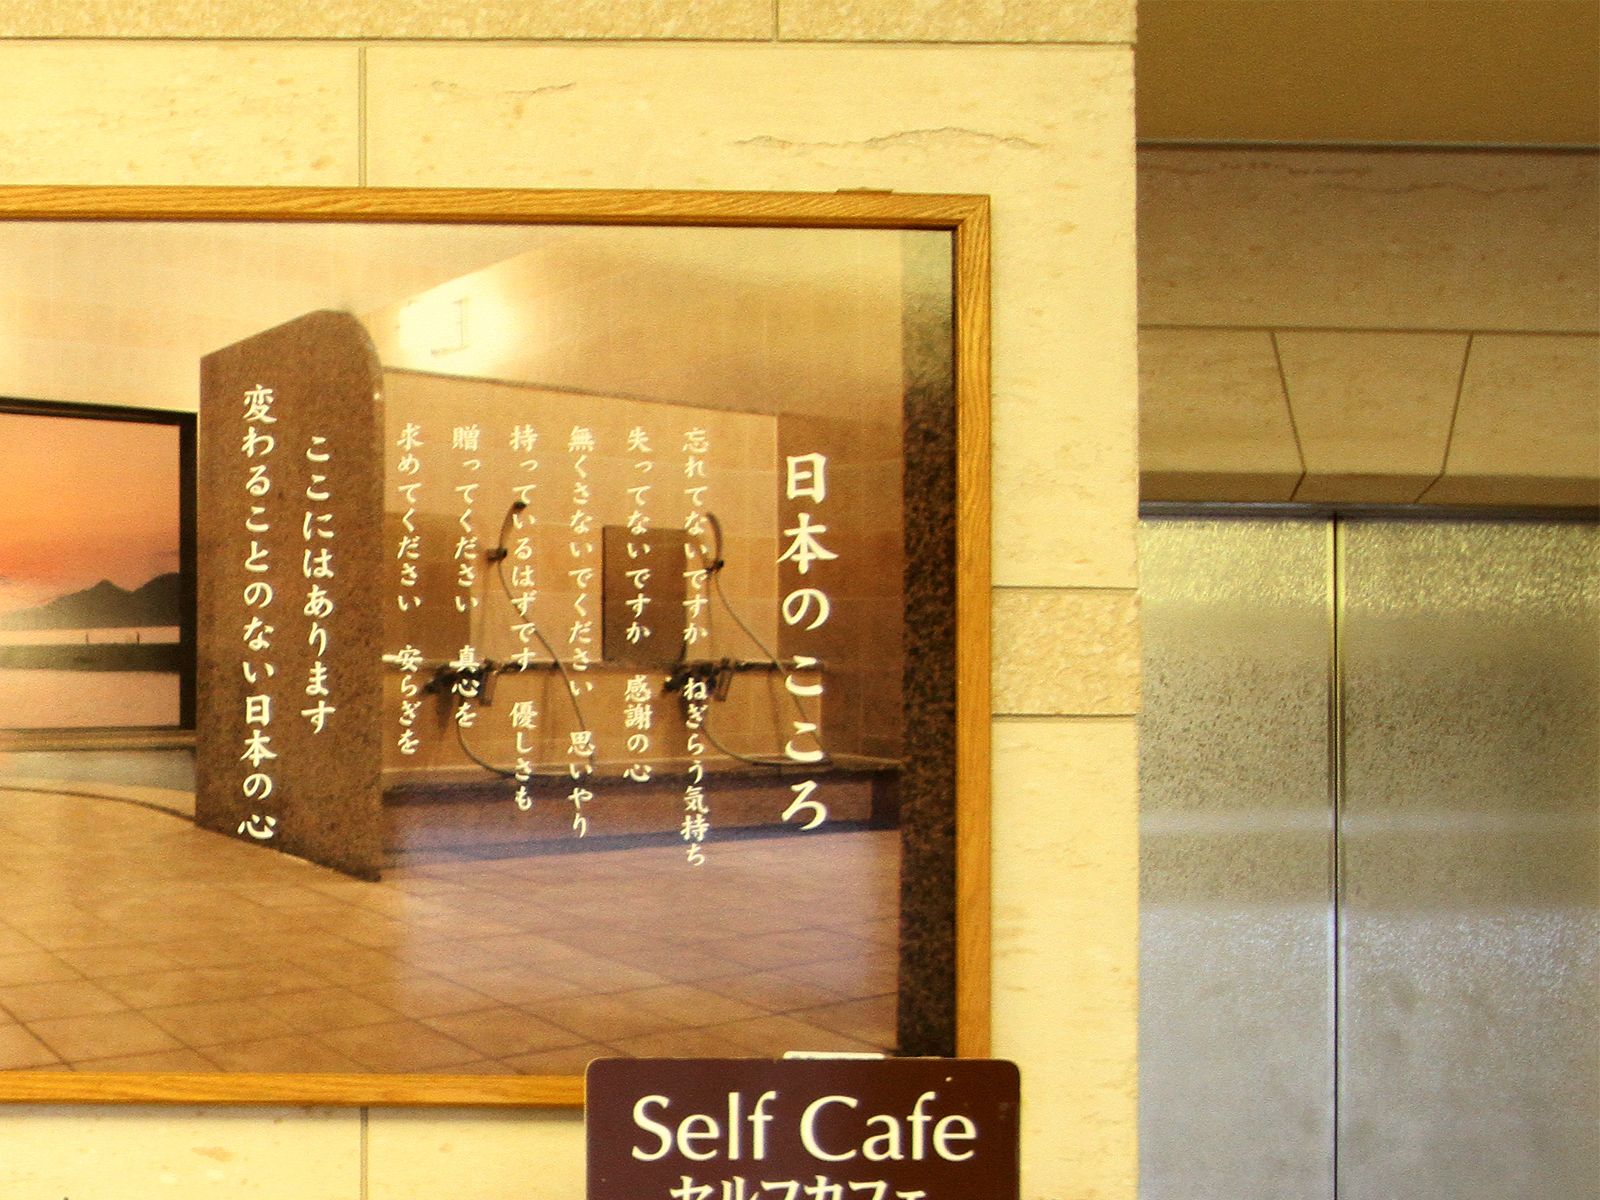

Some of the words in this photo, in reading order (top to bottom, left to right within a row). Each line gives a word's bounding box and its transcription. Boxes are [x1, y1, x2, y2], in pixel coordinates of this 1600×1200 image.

[237, 384, 278, 840] 変わることのない日本の心
[301, 435, 336, 735] ここにはあります
[396, 423, 425, 612] 求めてください
[451, 425, 481, 613] 贈ってください
[510, 425, 538, 673] 持っているはずです
[567, 426, 596, 697] 無くさないでください
[625, 426, 652, 645] 失ってないですか
[681, 428, 709, 647] 忘れてないですか
[396, 644, 425, 756] 安らぎを
[450, 645, 481, 728] 真心を
[623, 675, 652, 782] 感謝の心
[776, 452, 839, 830] 日本のこころ
[509, 701, 538, 811] 優しさも
[567, 731, 595, 839] 思いやり
[681, 676, 710, 866] ねぎらう気持ち
[631, 1091, 777, 1162] Self
[799, 1091, 978, 1162] Cafe
